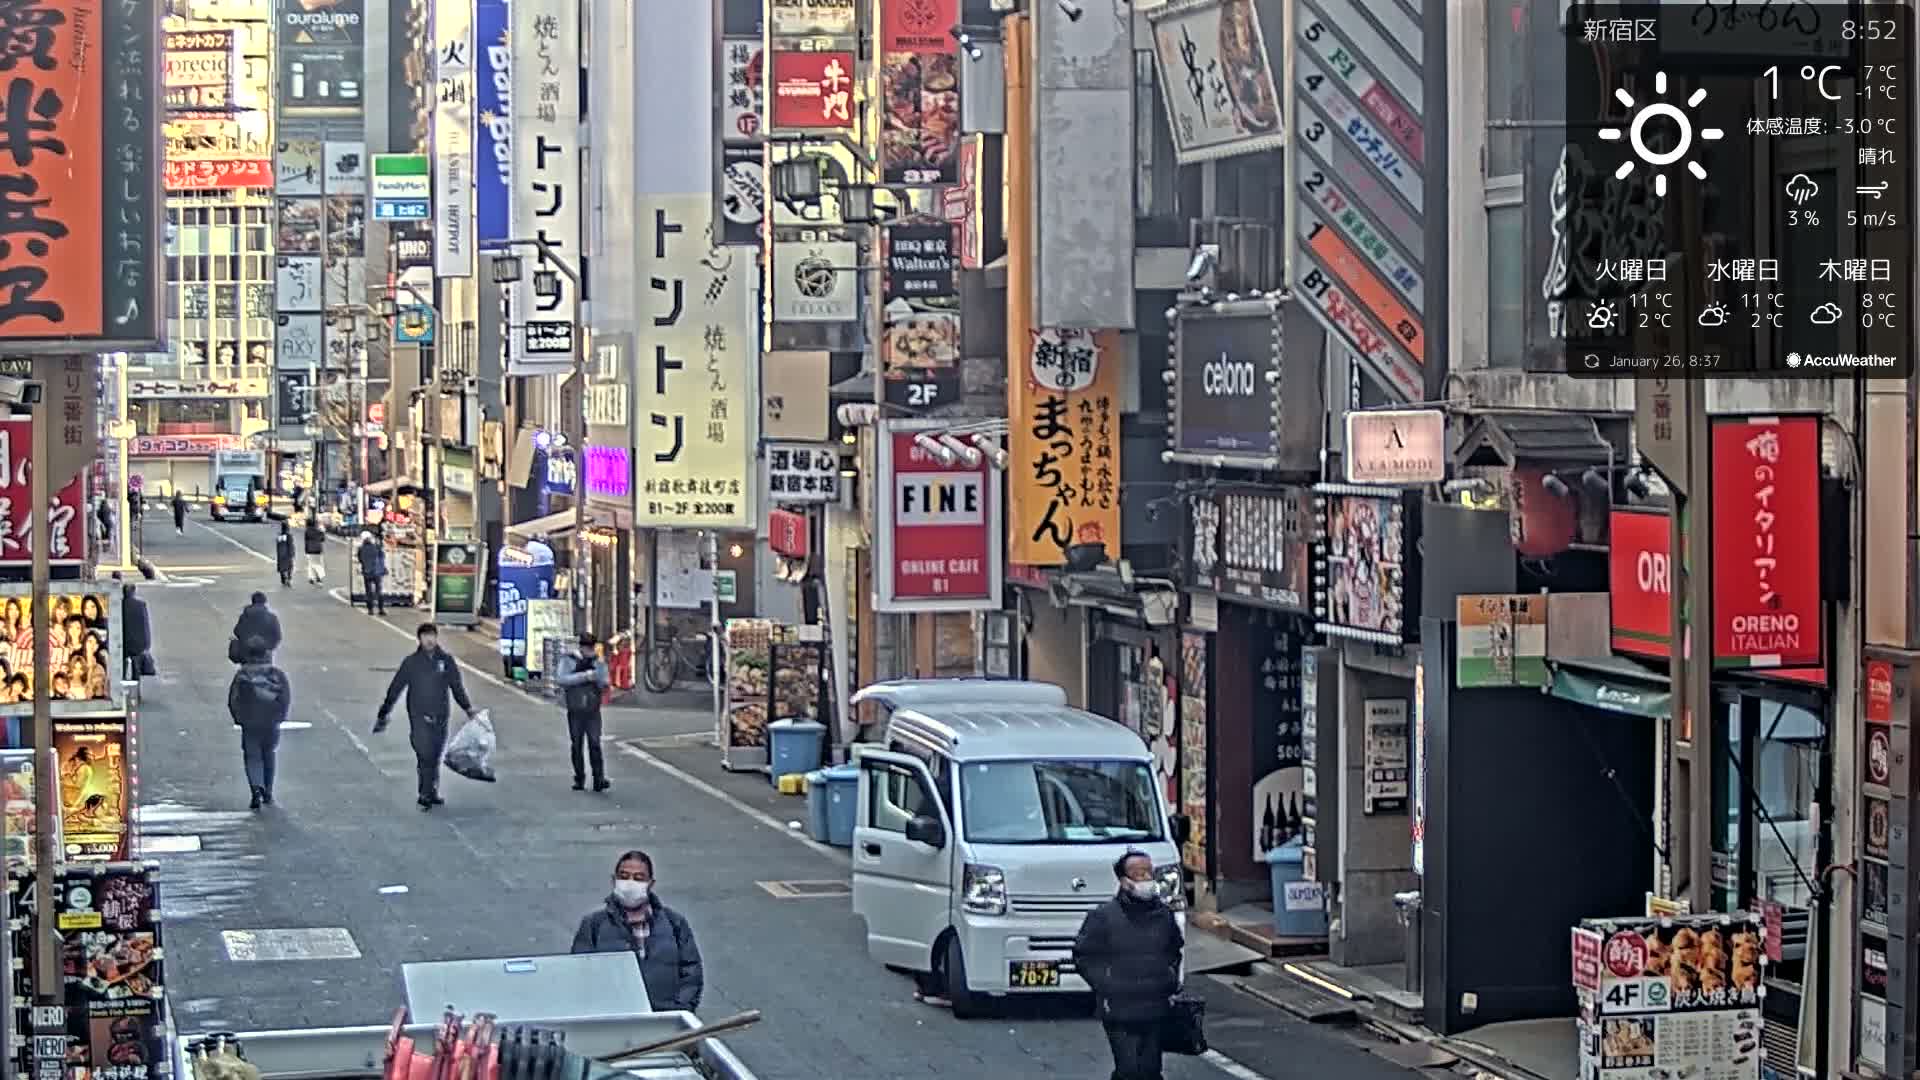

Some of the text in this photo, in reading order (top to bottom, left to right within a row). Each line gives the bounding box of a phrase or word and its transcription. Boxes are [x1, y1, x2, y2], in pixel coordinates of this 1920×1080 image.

[1305, 22, 1325, 42] 5
[1305, 74, 1325, 91] 4
[1306, 122, 1325, 142] 3
[1305, 172, 1324, 193] 2
[531, 135, 561, 313] トントン
[892, 256, 950, 271] Walton's
[1304, 269, 1330, 297] B1
[651, 209, 682, 461] トントン
[1203, 351, 1255, 396] celona
[908, 384, 937, 405] 2F
[770, 450, 835, 471] 酒場心
[1032, 395, 1076, 548] まっちゃん
[770, 474, 835, 493] 新宿本店
[903, 484, 978, 513] FINE
[1745, 430, 1780, 603] 俺のイタリアン
[901, 559, 945, 575] ONLINE
[933, 578, 950, 592] B1
[1732, 614, 1799, 633] ORENO
[1731, 634, 1800, 650] ITALIAN
[1606, 984, 1639, 1006] 4F
[34, 1006, 63, 1026] NERO
